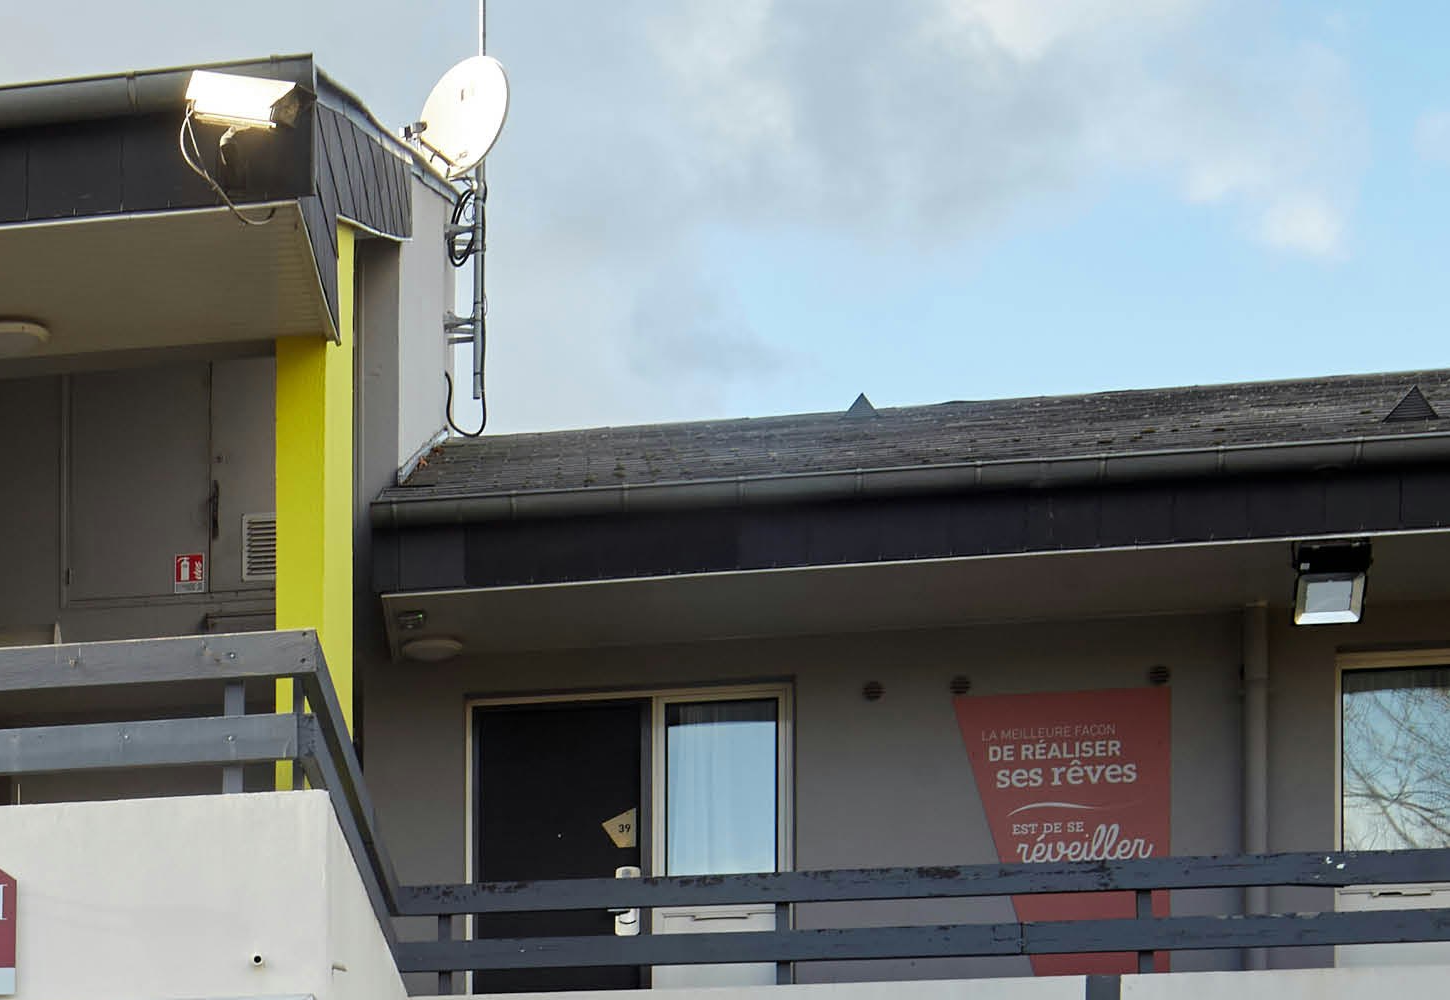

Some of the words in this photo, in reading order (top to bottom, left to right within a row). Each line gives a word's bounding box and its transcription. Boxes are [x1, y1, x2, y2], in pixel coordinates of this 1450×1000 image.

[982, 730, 997, 741] LA
[1000, 725, 1071, 740] MEILLEURE
[988, 745, 1014, 762] DE
[1021, 740, 1121, 760] RÉALISER
[996, 767, 1043, 788] ses
[1051, 759, 1137, 786] rêves
[619, 823, 631, 833] 39
[1012, 824, 1038, 835] EST
[1043, 822, 1062, 834] DE
[1067, 821, 1084, 832] SE
[1016, 824, 1154, 863] réveiller
